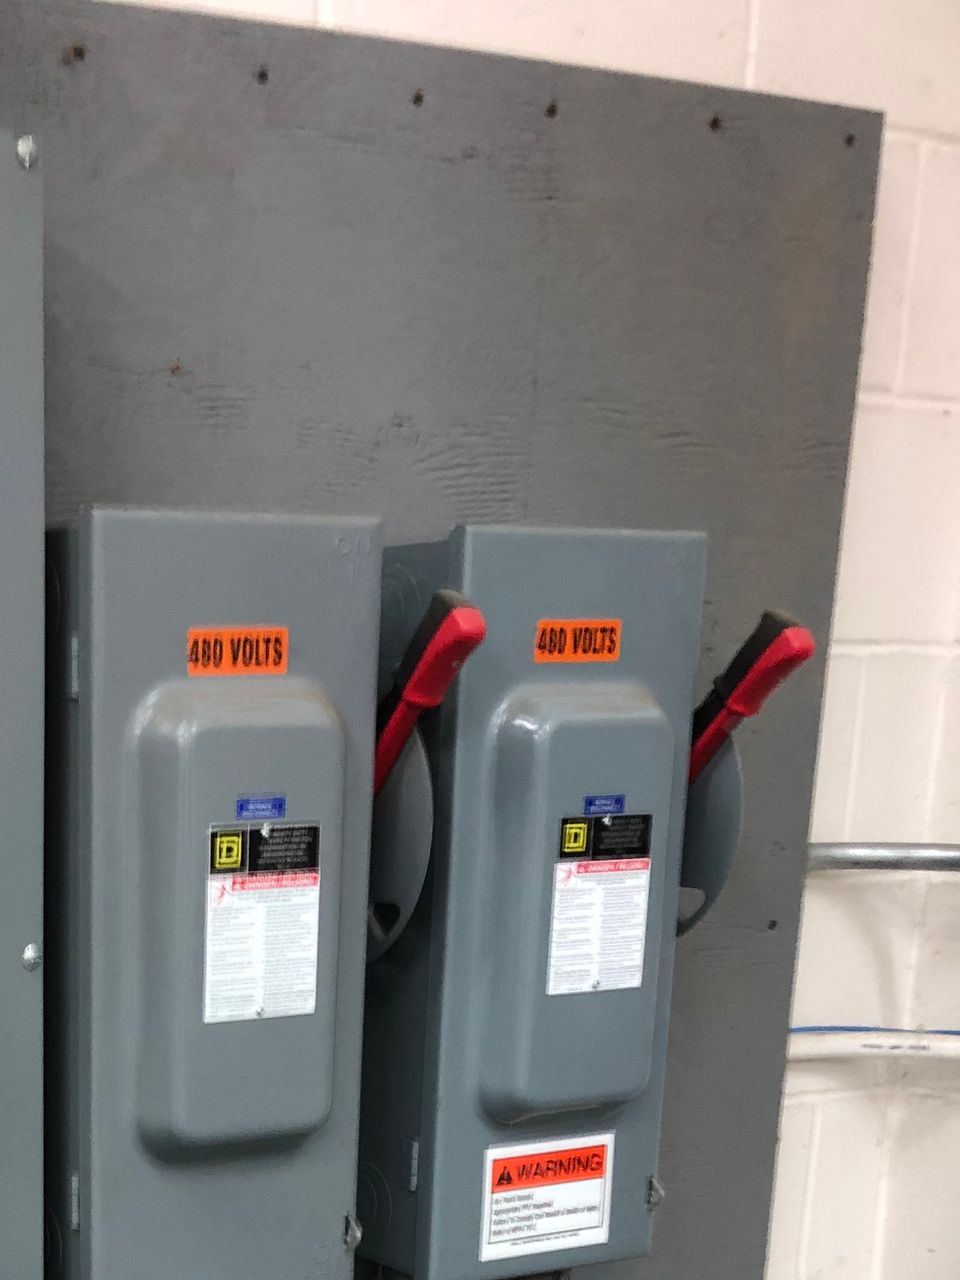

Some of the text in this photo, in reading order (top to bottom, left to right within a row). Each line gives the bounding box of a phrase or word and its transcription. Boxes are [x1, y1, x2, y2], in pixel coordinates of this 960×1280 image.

[188, 635, 283, 668] 480 VOLTS
[573, 626, 617, 655] VOLTS
[516, 1152, 602, 1180] WARNING
